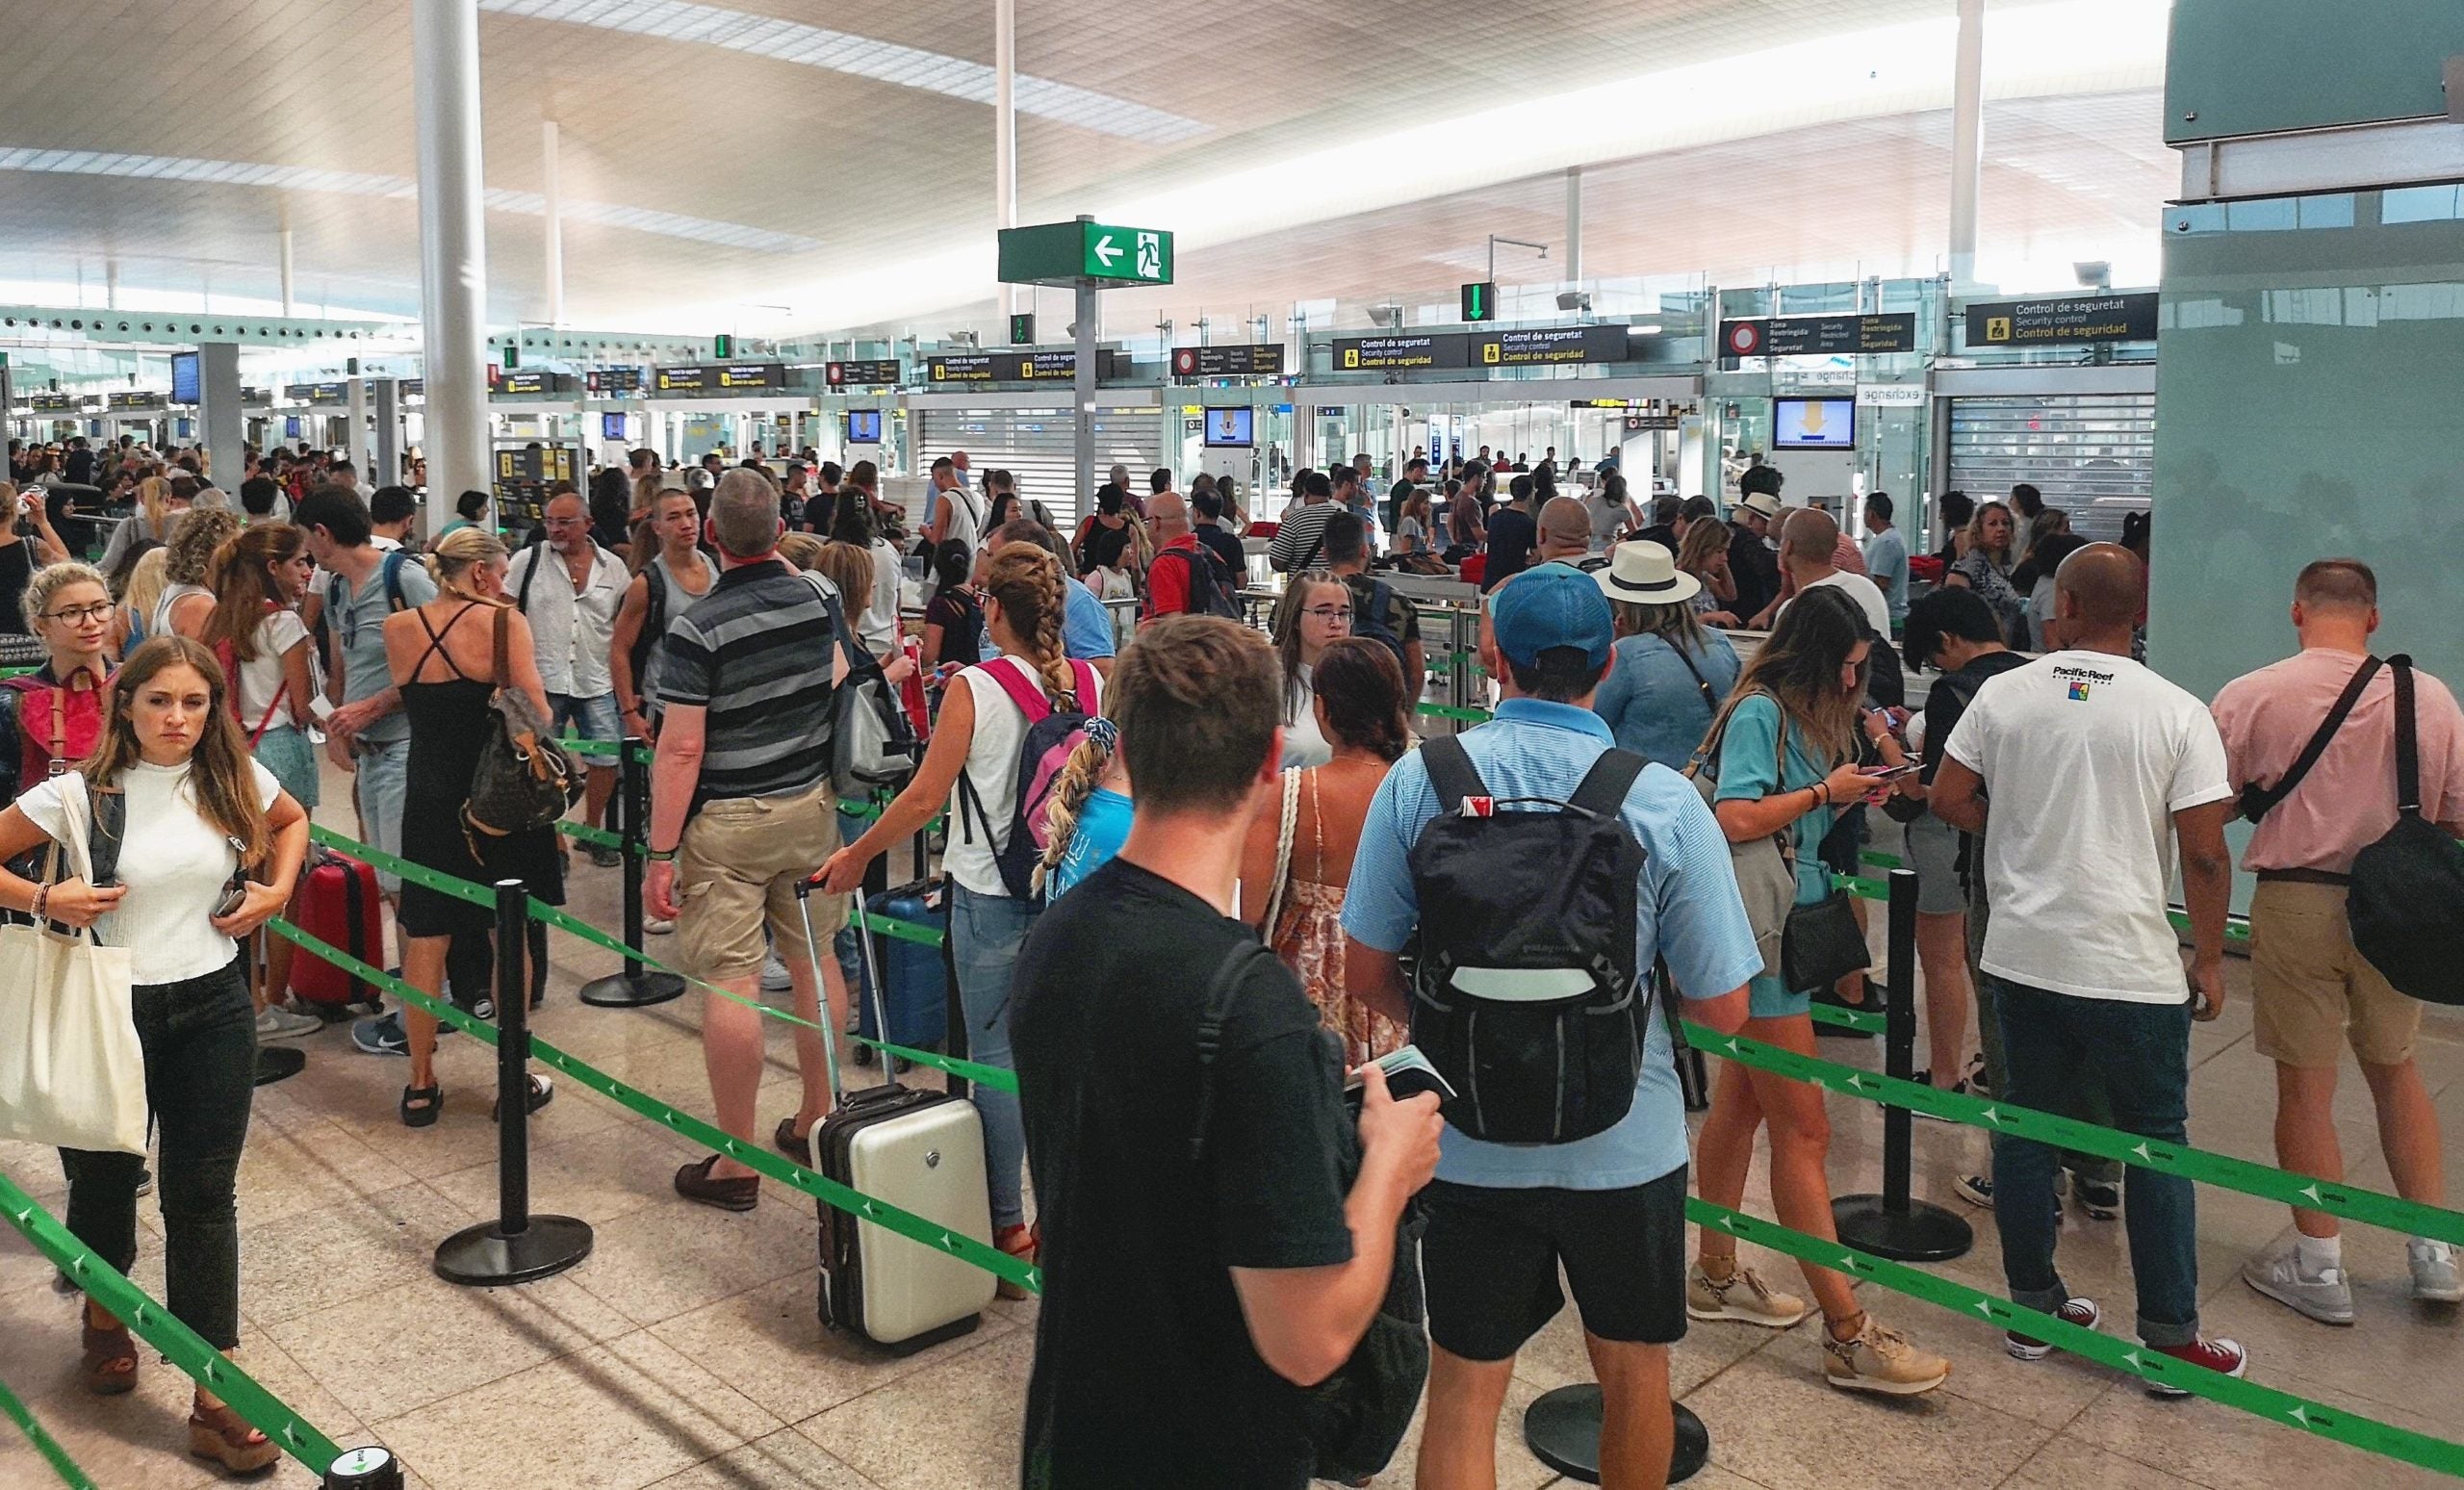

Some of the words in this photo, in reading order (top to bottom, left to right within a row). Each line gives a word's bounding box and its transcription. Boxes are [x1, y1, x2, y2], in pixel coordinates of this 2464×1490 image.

[2016, 304, 2053, 316] Control
[2058, 303, 2069, 312] de
[2074, 298, 2124, 313] seguretat
[2016, 316, 2051, 326] Security
[2055, 315, 2087, 324] control
[1503, 332, 1530, 342] Control
[1545, 331, 1582, 341] seguretat
[2016, 327, 2053, 339] Control
[2058, 327, 2069, 337] de
[2074, 323, 2127, 337] seguridad
[1398, 338, 1430, 347] seguretat
[1503, 352, 1530, 361] Control
[1532, 351, 1543, 360] de
[1545, 349, 1584, 361] seguridad
[1362, 357, 1385, 366] Control
[1398, 356, 1431, 366] seguridad
[2053, 666, 2087, 678] Pacific
[2088, 670, 2114, 681] Reef
